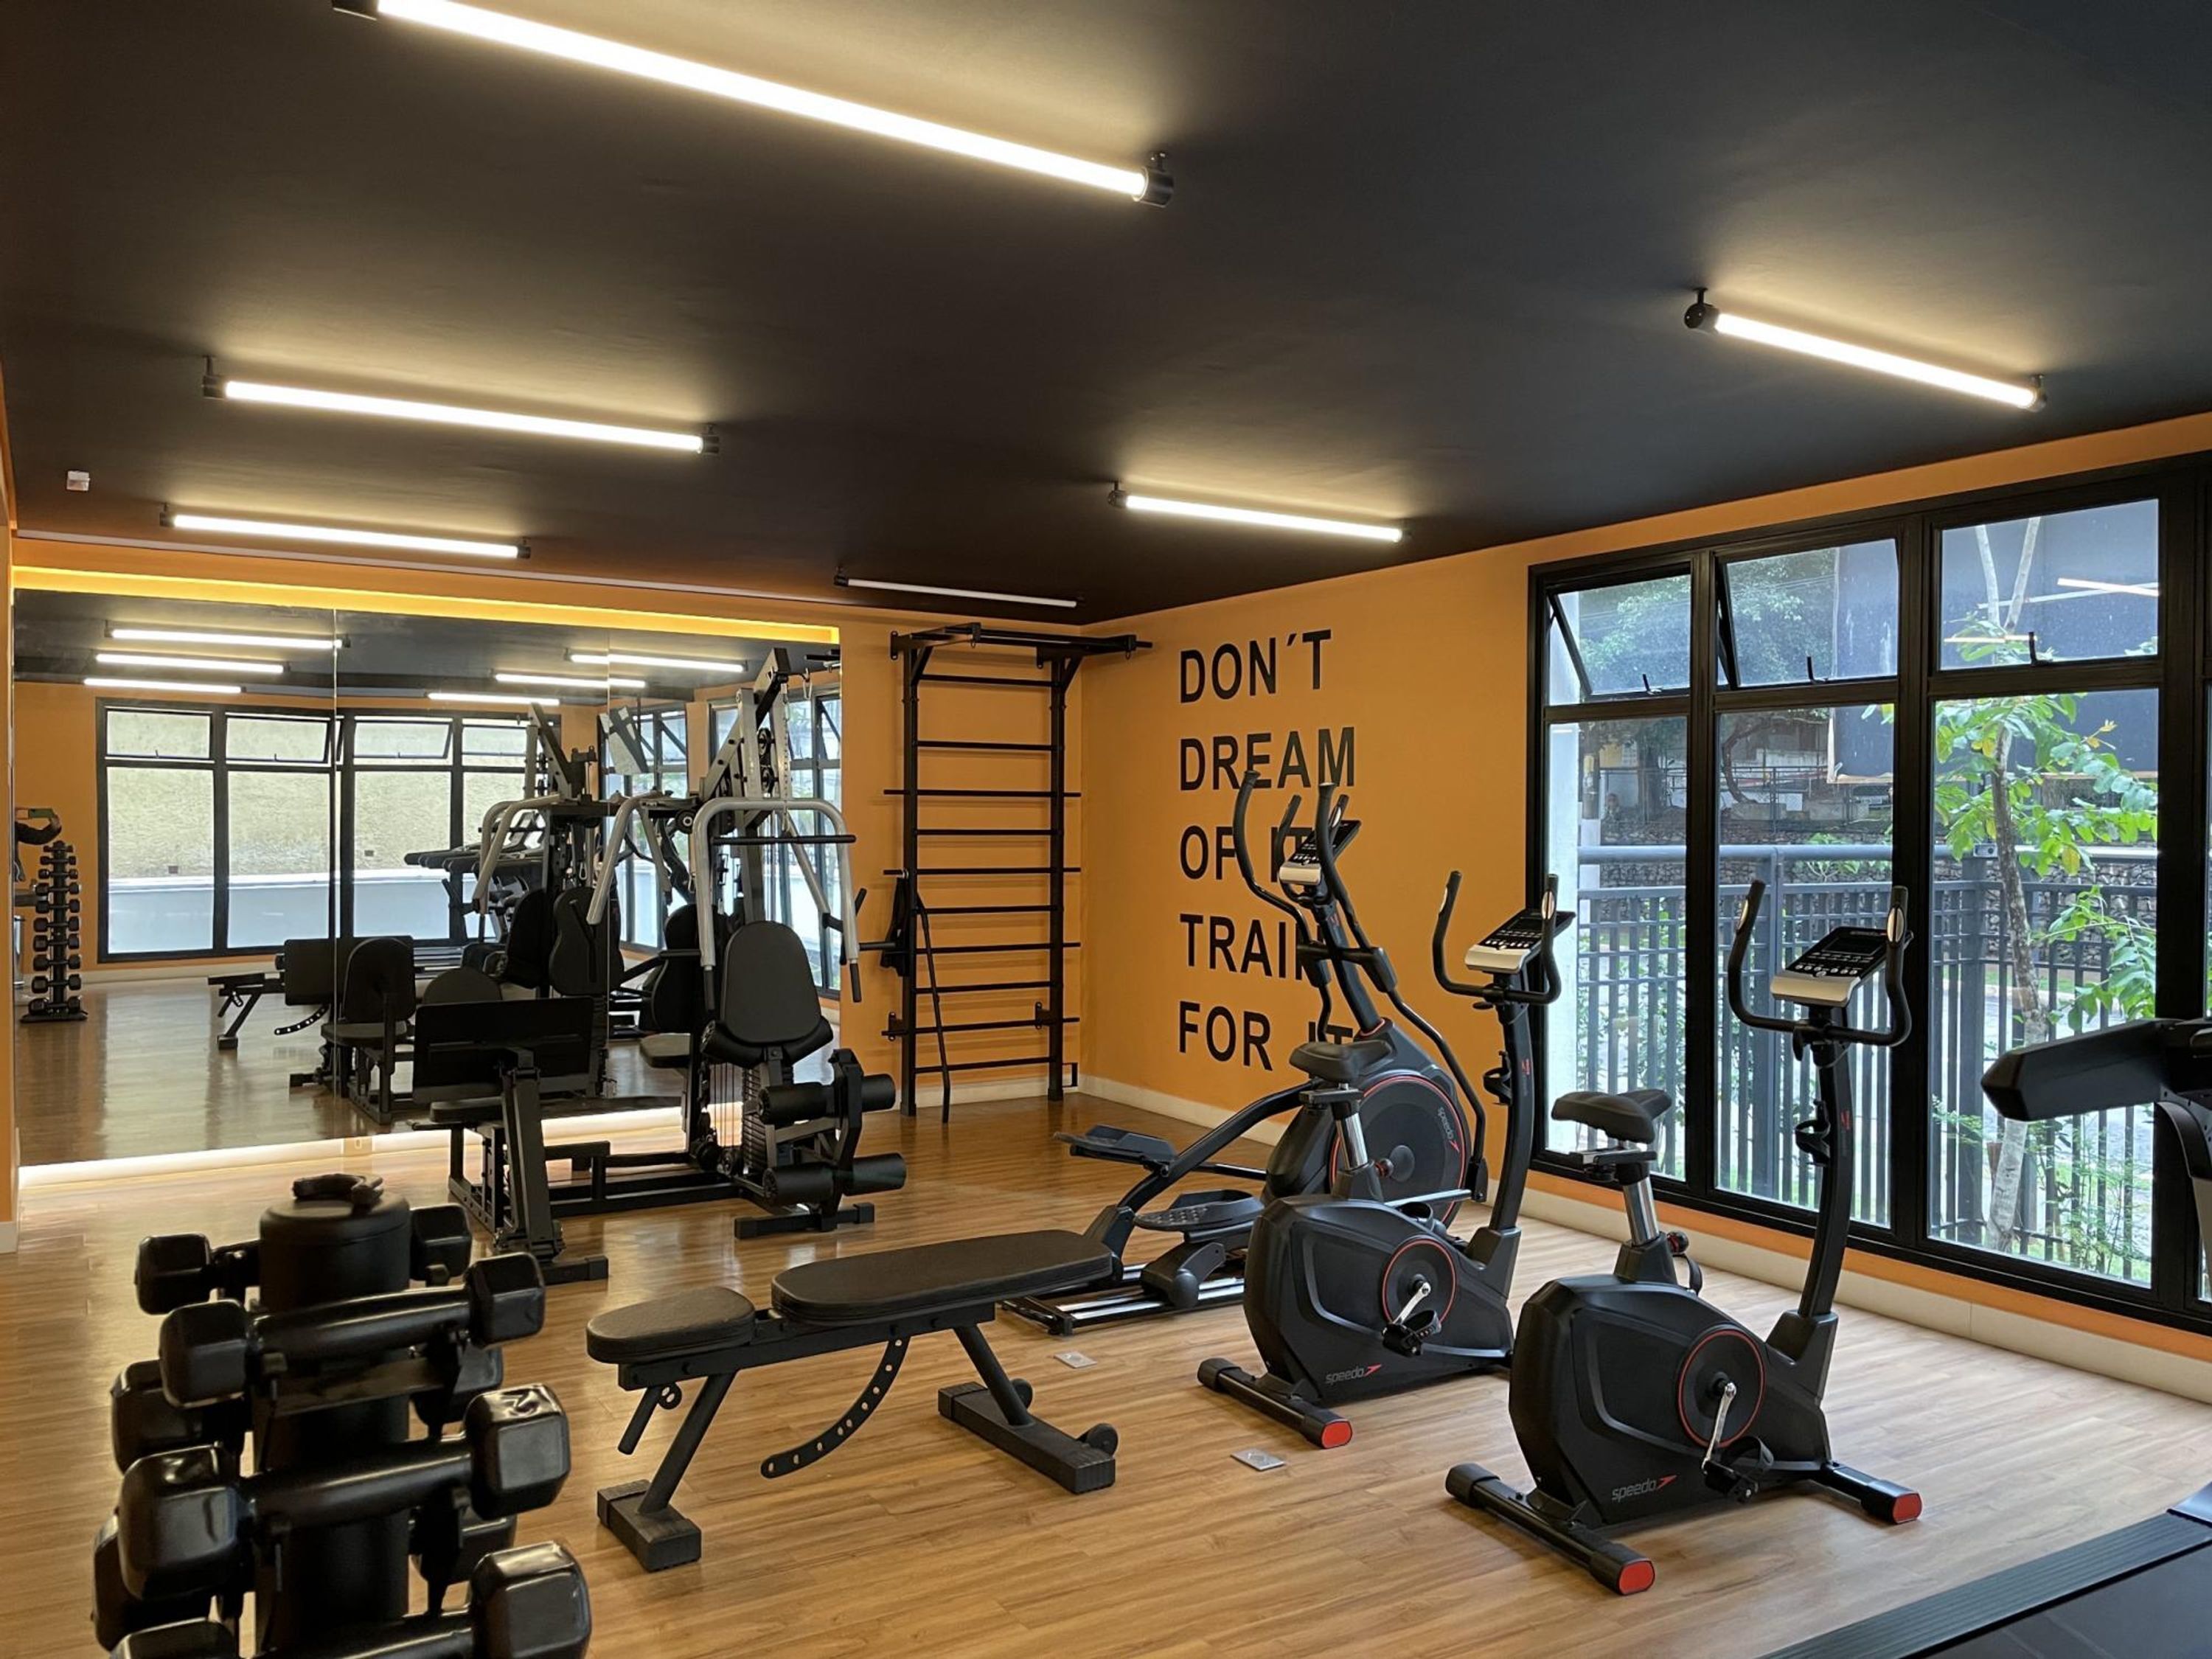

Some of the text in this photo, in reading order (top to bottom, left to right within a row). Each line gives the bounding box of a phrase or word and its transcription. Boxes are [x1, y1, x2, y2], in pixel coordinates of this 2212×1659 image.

[1180, 629, 1332, 703] DON'T
[1180, 726, 1355, 792] DREAM
[1180, 825, 1238, 880] OF
[1180, 1001, 1273, 1071] FOR
[1325, 1366, 1365, 1385] speedo
[1611, 1478, 1658, 1503] speedo
